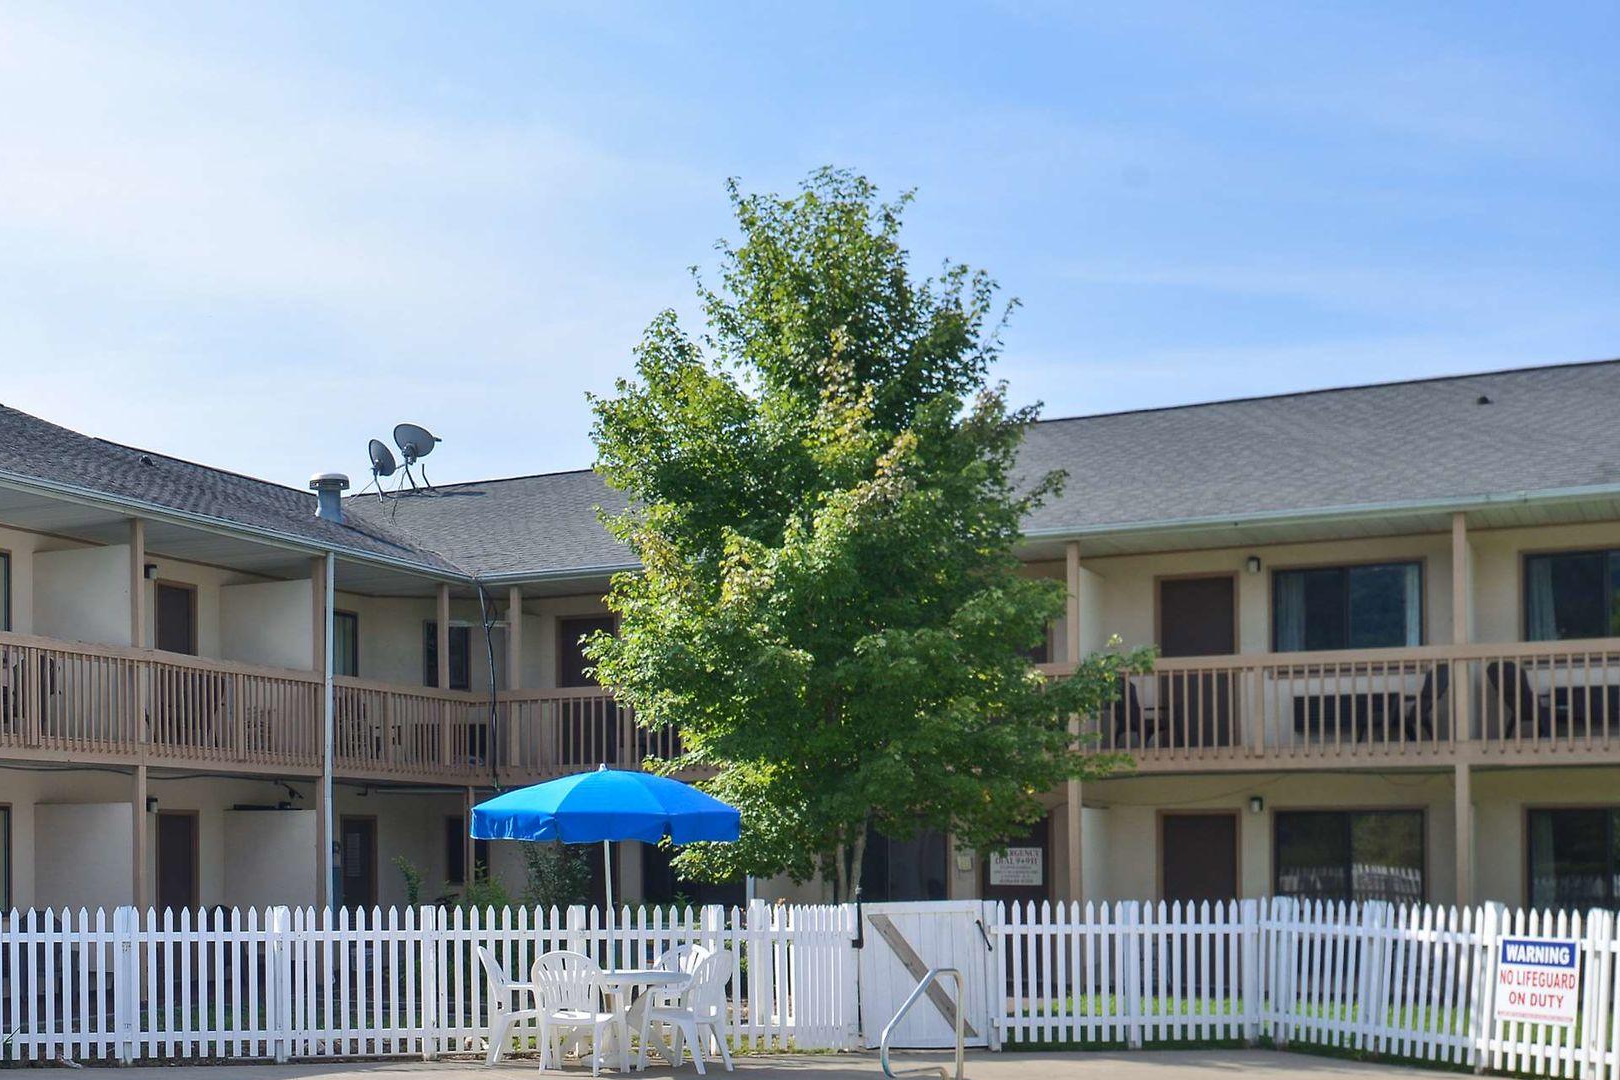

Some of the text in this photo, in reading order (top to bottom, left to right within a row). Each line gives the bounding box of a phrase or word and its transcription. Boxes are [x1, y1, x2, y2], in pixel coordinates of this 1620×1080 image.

[1506, 944, 1570, 965] WARNING
[1500, 970, 1576, 990] NO LIFEGUARD
[1509, 991, 1564, 1008] ON DUTY
